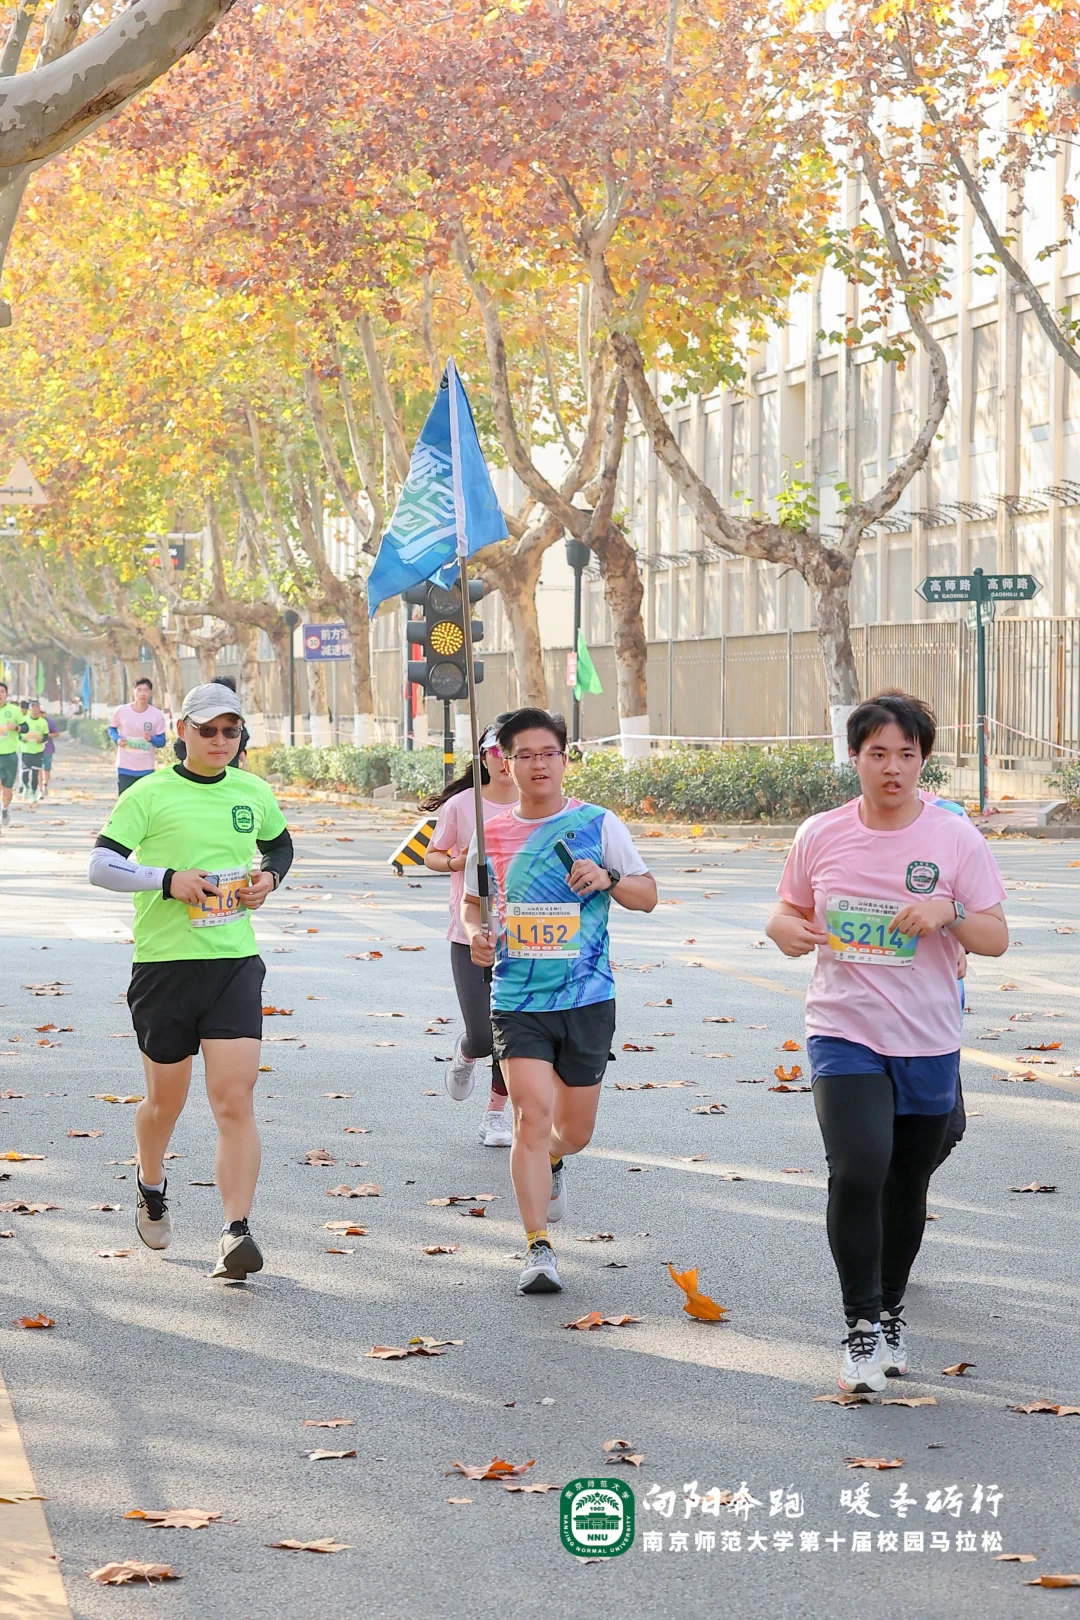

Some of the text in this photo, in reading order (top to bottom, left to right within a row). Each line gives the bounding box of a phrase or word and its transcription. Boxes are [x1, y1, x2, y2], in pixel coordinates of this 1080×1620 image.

[930, 579, 971, 592] 高师路
[987, 577, 1028, 590] 高师路
[517, 924, 568, 944] L152
[840, 921, 903, 949] S214
